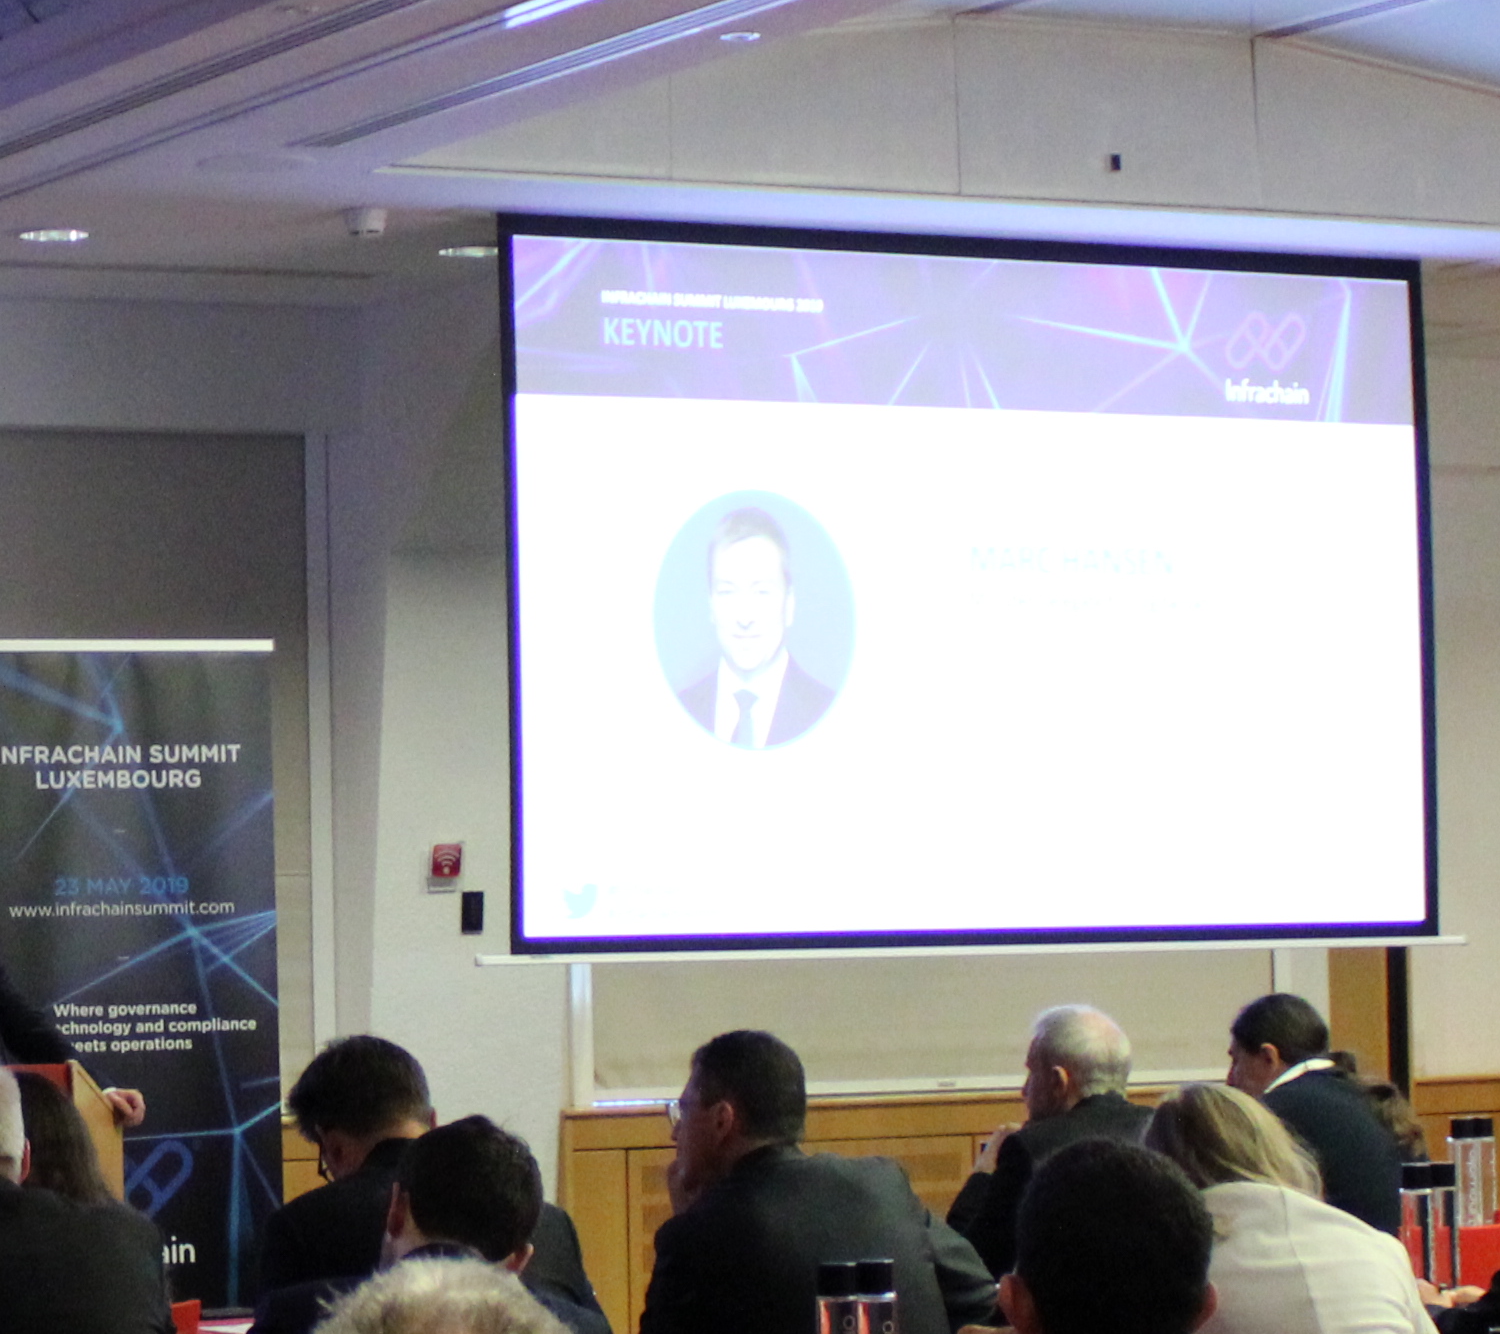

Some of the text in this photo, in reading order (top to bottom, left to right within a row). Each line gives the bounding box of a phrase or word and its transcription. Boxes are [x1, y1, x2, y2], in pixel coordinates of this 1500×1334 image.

[603, 317, 724, 349] KEYNOTE
[1225, 377, 1310, 405] Infrachain
[149, 744, 242, 764] SUMMIT
[35, 769, 202, 790] LUXEMBOURG
[54, 876, 190, 896] 23 MAY 2019
[9, 899, 235, 918] www.infrachainsummit.com
[53, 1003, 197, 1019] Where governance
[56, 1018, 258, 1036] chnology and compliance
[71, 1037, 193, 1054] eets operations
